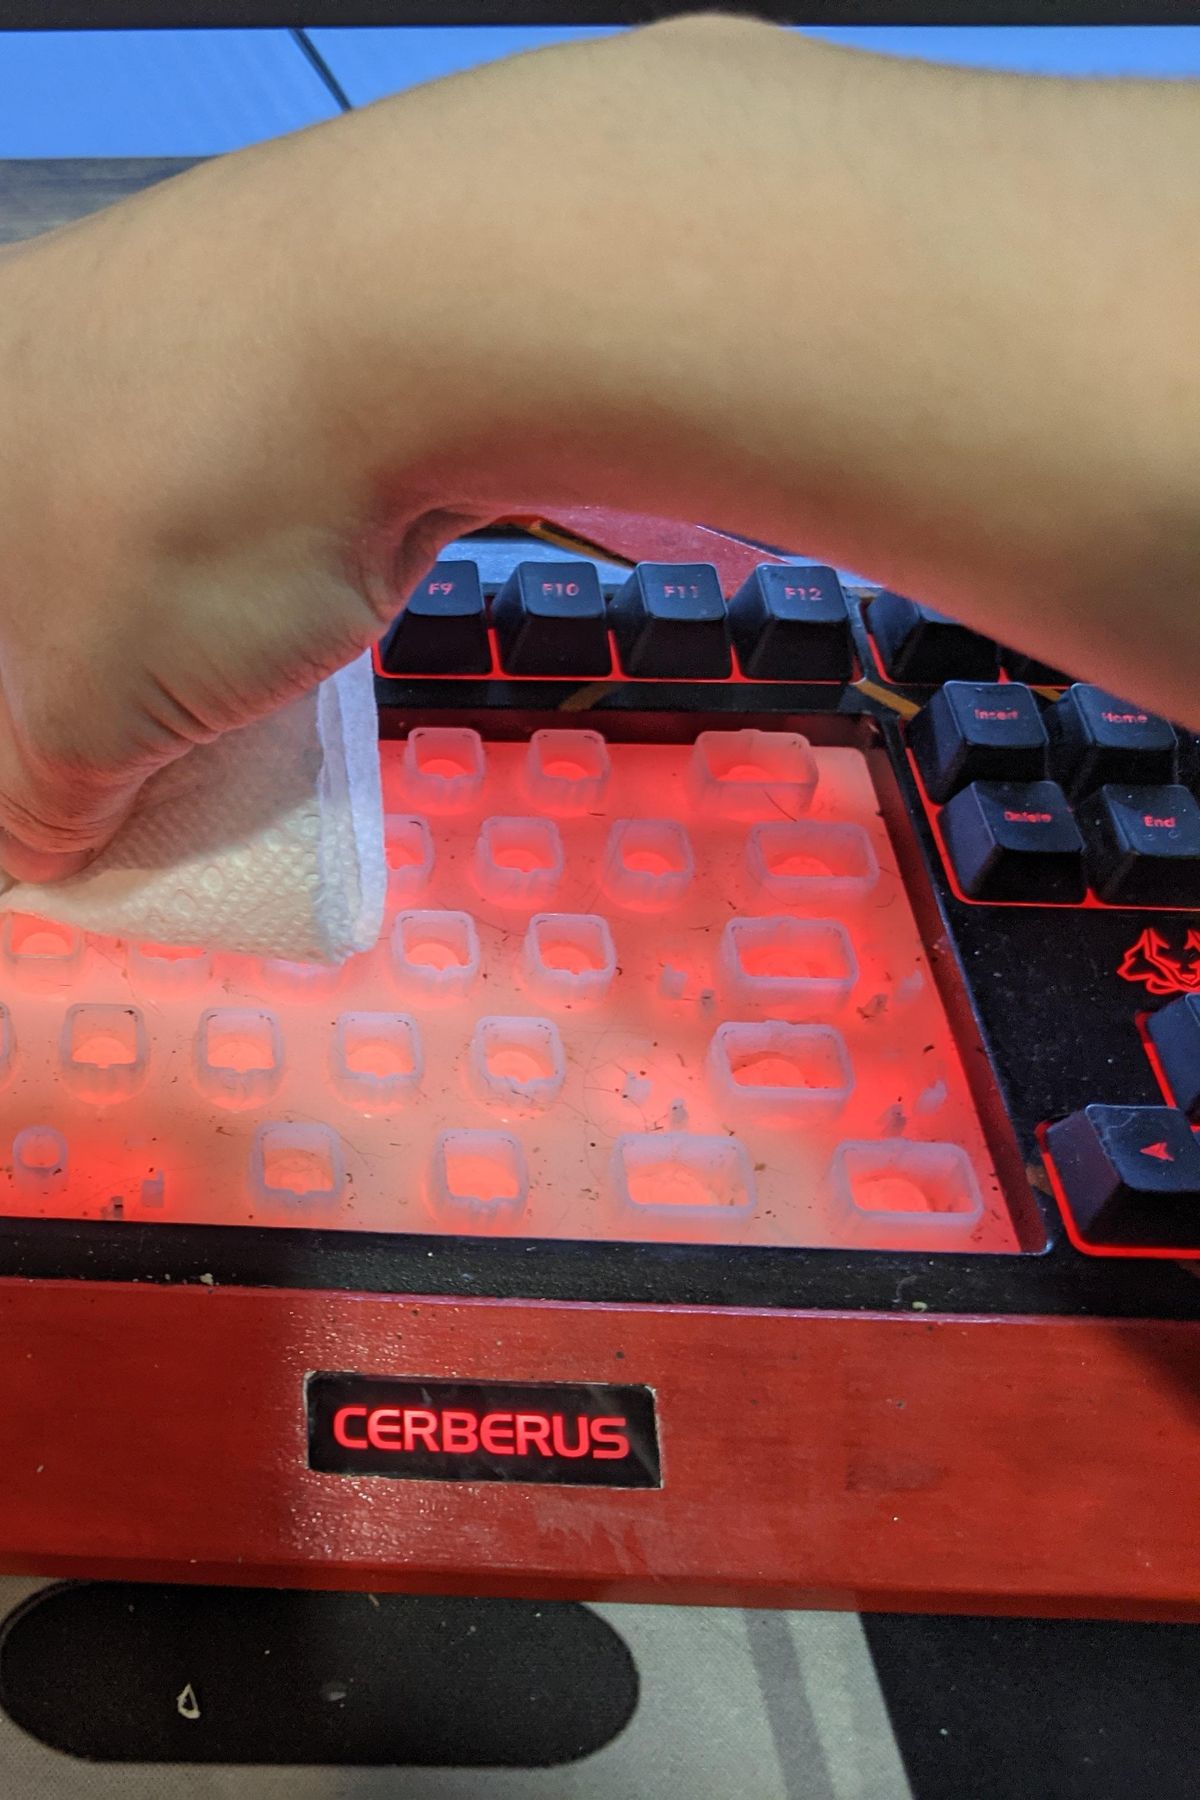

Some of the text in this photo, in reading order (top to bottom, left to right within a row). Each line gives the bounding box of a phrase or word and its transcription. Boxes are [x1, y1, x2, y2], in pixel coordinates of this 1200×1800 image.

[428, 582, 454, 595] F9
[542, 582, 580, 597] F10
[664, 585, 698, 599] F11
[785, 587, 823, 601] F12
[974, 709, 1019, 721] Insert
[1101, 712, 1148, 724] Home
[1143, 815, 1176, 828] End
[332, 1406, 631, 1460] CERBERUS
